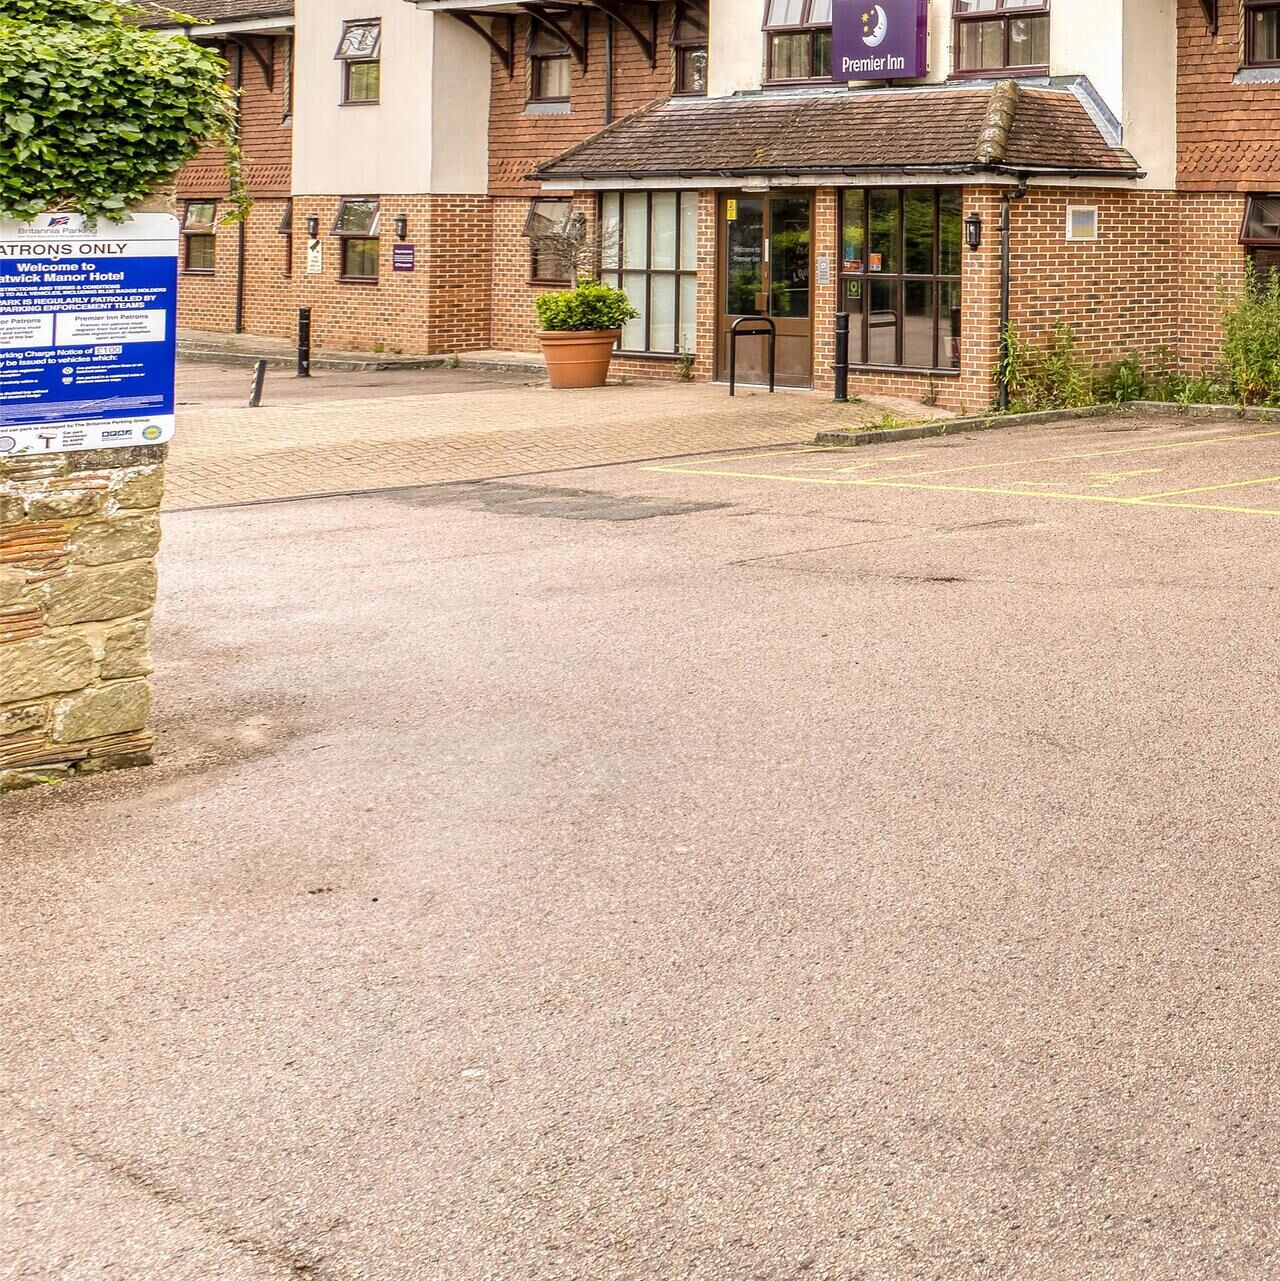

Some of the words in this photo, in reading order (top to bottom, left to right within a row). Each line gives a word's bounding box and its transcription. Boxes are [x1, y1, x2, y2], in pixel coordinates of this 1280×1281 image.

[842, 55, 885, 73] Premier
[887, 53, 905, 70] Inn
[62, 227, 98, 235] Parking
[79, 243, 127, 254] ONLY
[17, 263, 78, 272] Welcome
[81, 262, 95, 271] to
[44, 273, 86, 282] Manor
[89, 272, 124, 281] Hotel
[34, 297, 89, 305] REGULARLY
[90, 295, 143, 303] PATROLLED
[43, 303, 112, 311] ENFORCEMENT
[25, 350, 56, 358] Charge
[57, 348, 83, 356] Notice
[96, 346, 121, 354] £100
[92, 354, 118, 362] which:
